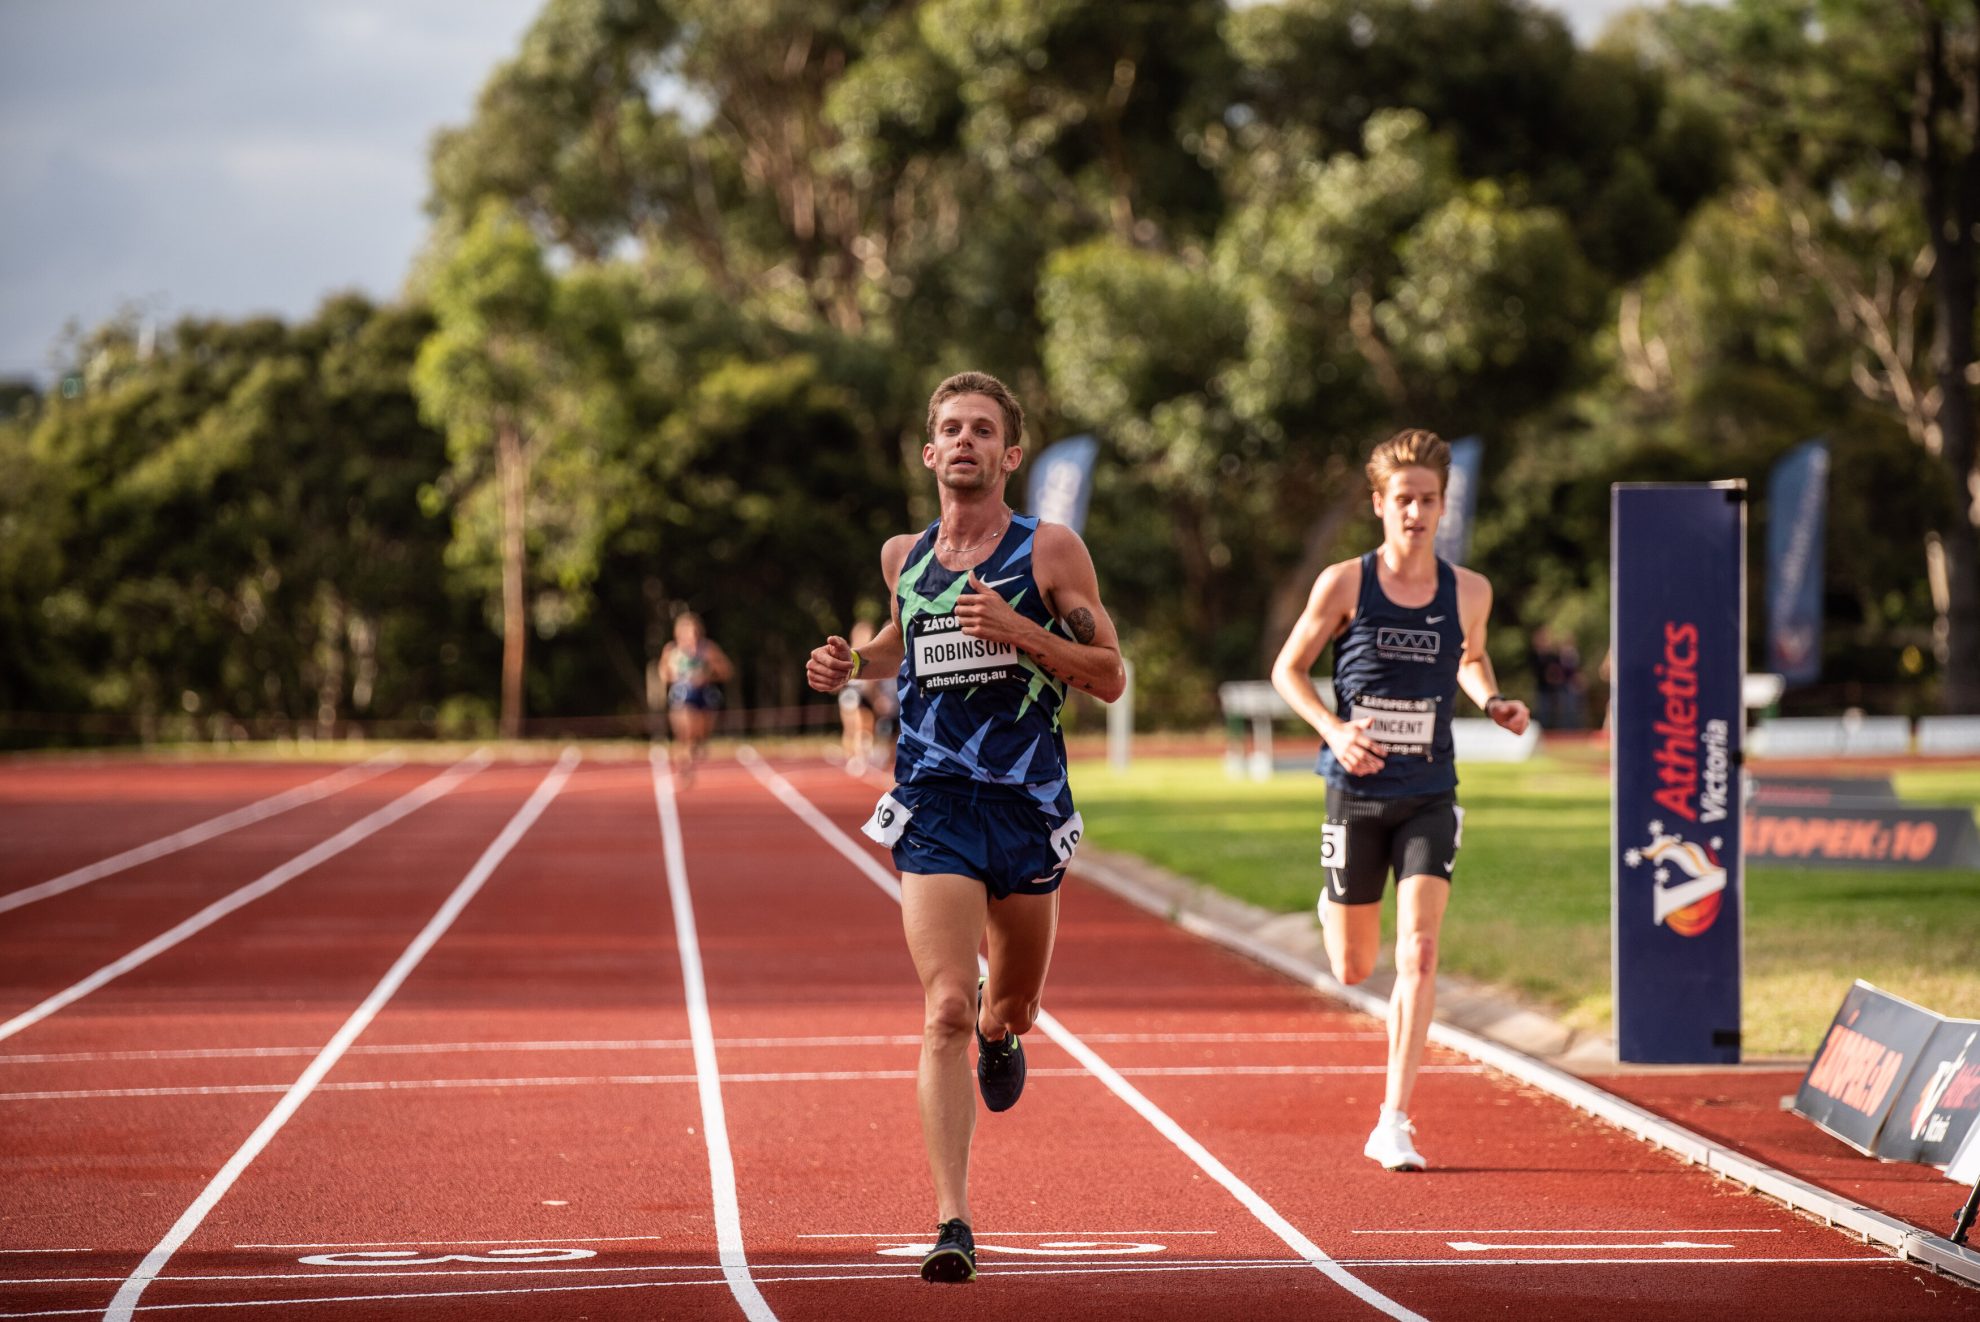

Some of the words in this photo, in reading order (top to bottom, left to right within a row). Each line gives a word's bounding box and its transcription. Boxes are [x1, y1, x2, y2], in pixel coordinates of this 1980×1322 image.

[924, 640, 1011, 664] ROBINSON
[926, 670, 1007, 688] athsvic.org.au
[1653, 621, 1699, 822] Athletics
[1700, 718, 1728, 823] Victoria
[876, 803, 896, 829] 19
[1744, 807, 1938, 861] ÁTOPEK:10
[298, 1248, 598, 1266] 3
